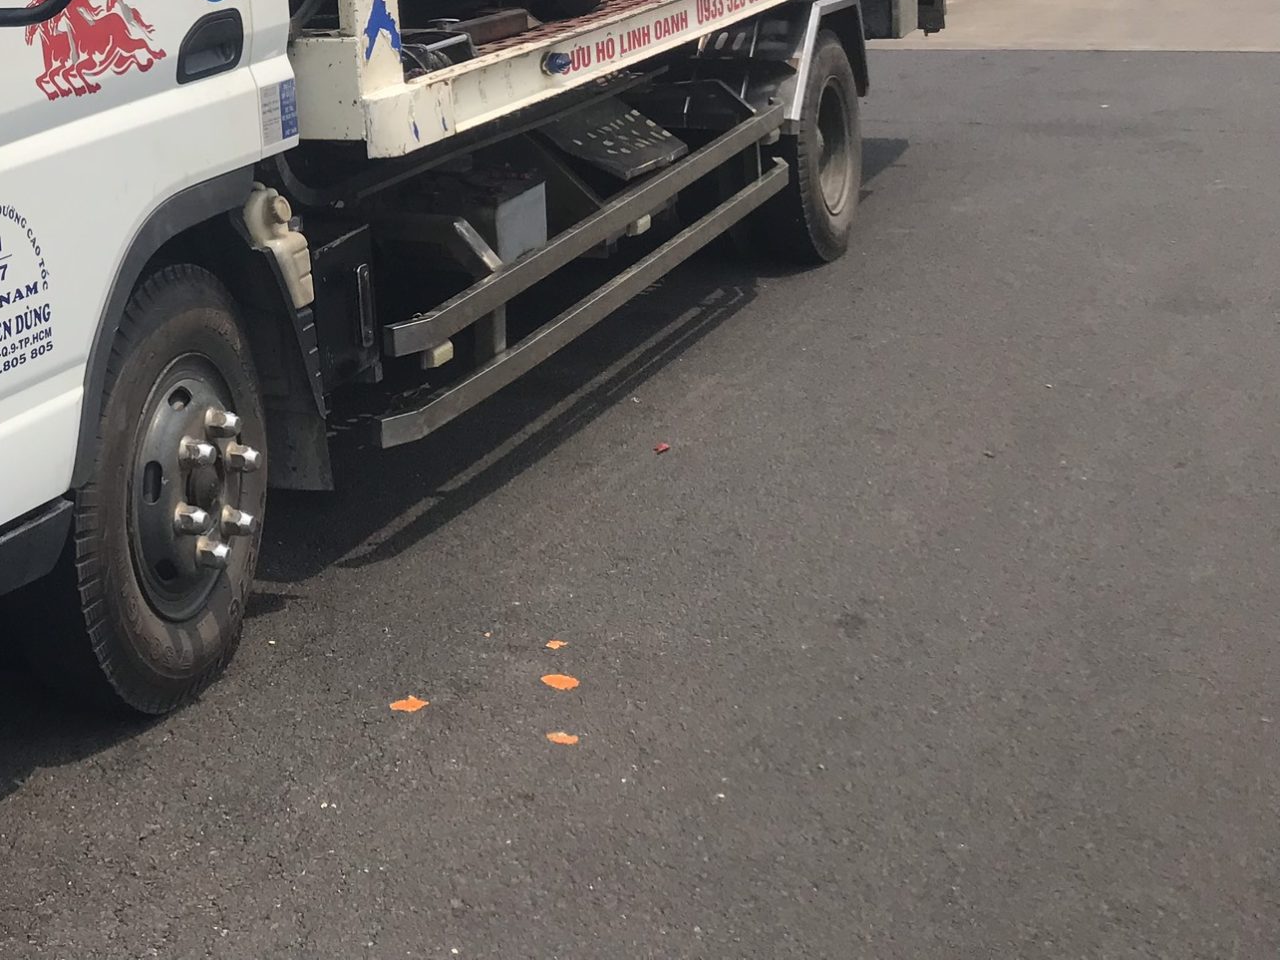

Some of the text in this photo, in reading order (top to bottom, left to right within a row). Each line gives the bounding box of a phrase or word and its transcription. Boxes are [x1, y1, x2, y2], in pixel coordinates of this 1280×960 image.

[562, 43, 592, 75] ỨU
[619, 25, 651, 54] LINH
[654, 10, 688, 40] OANH
[26, 228, 41, 257] CAO
[39, 257, 50, 291] TỐC
[15, 303, 51, 335] DÙNG
[30, 341, 53, 359] 805
